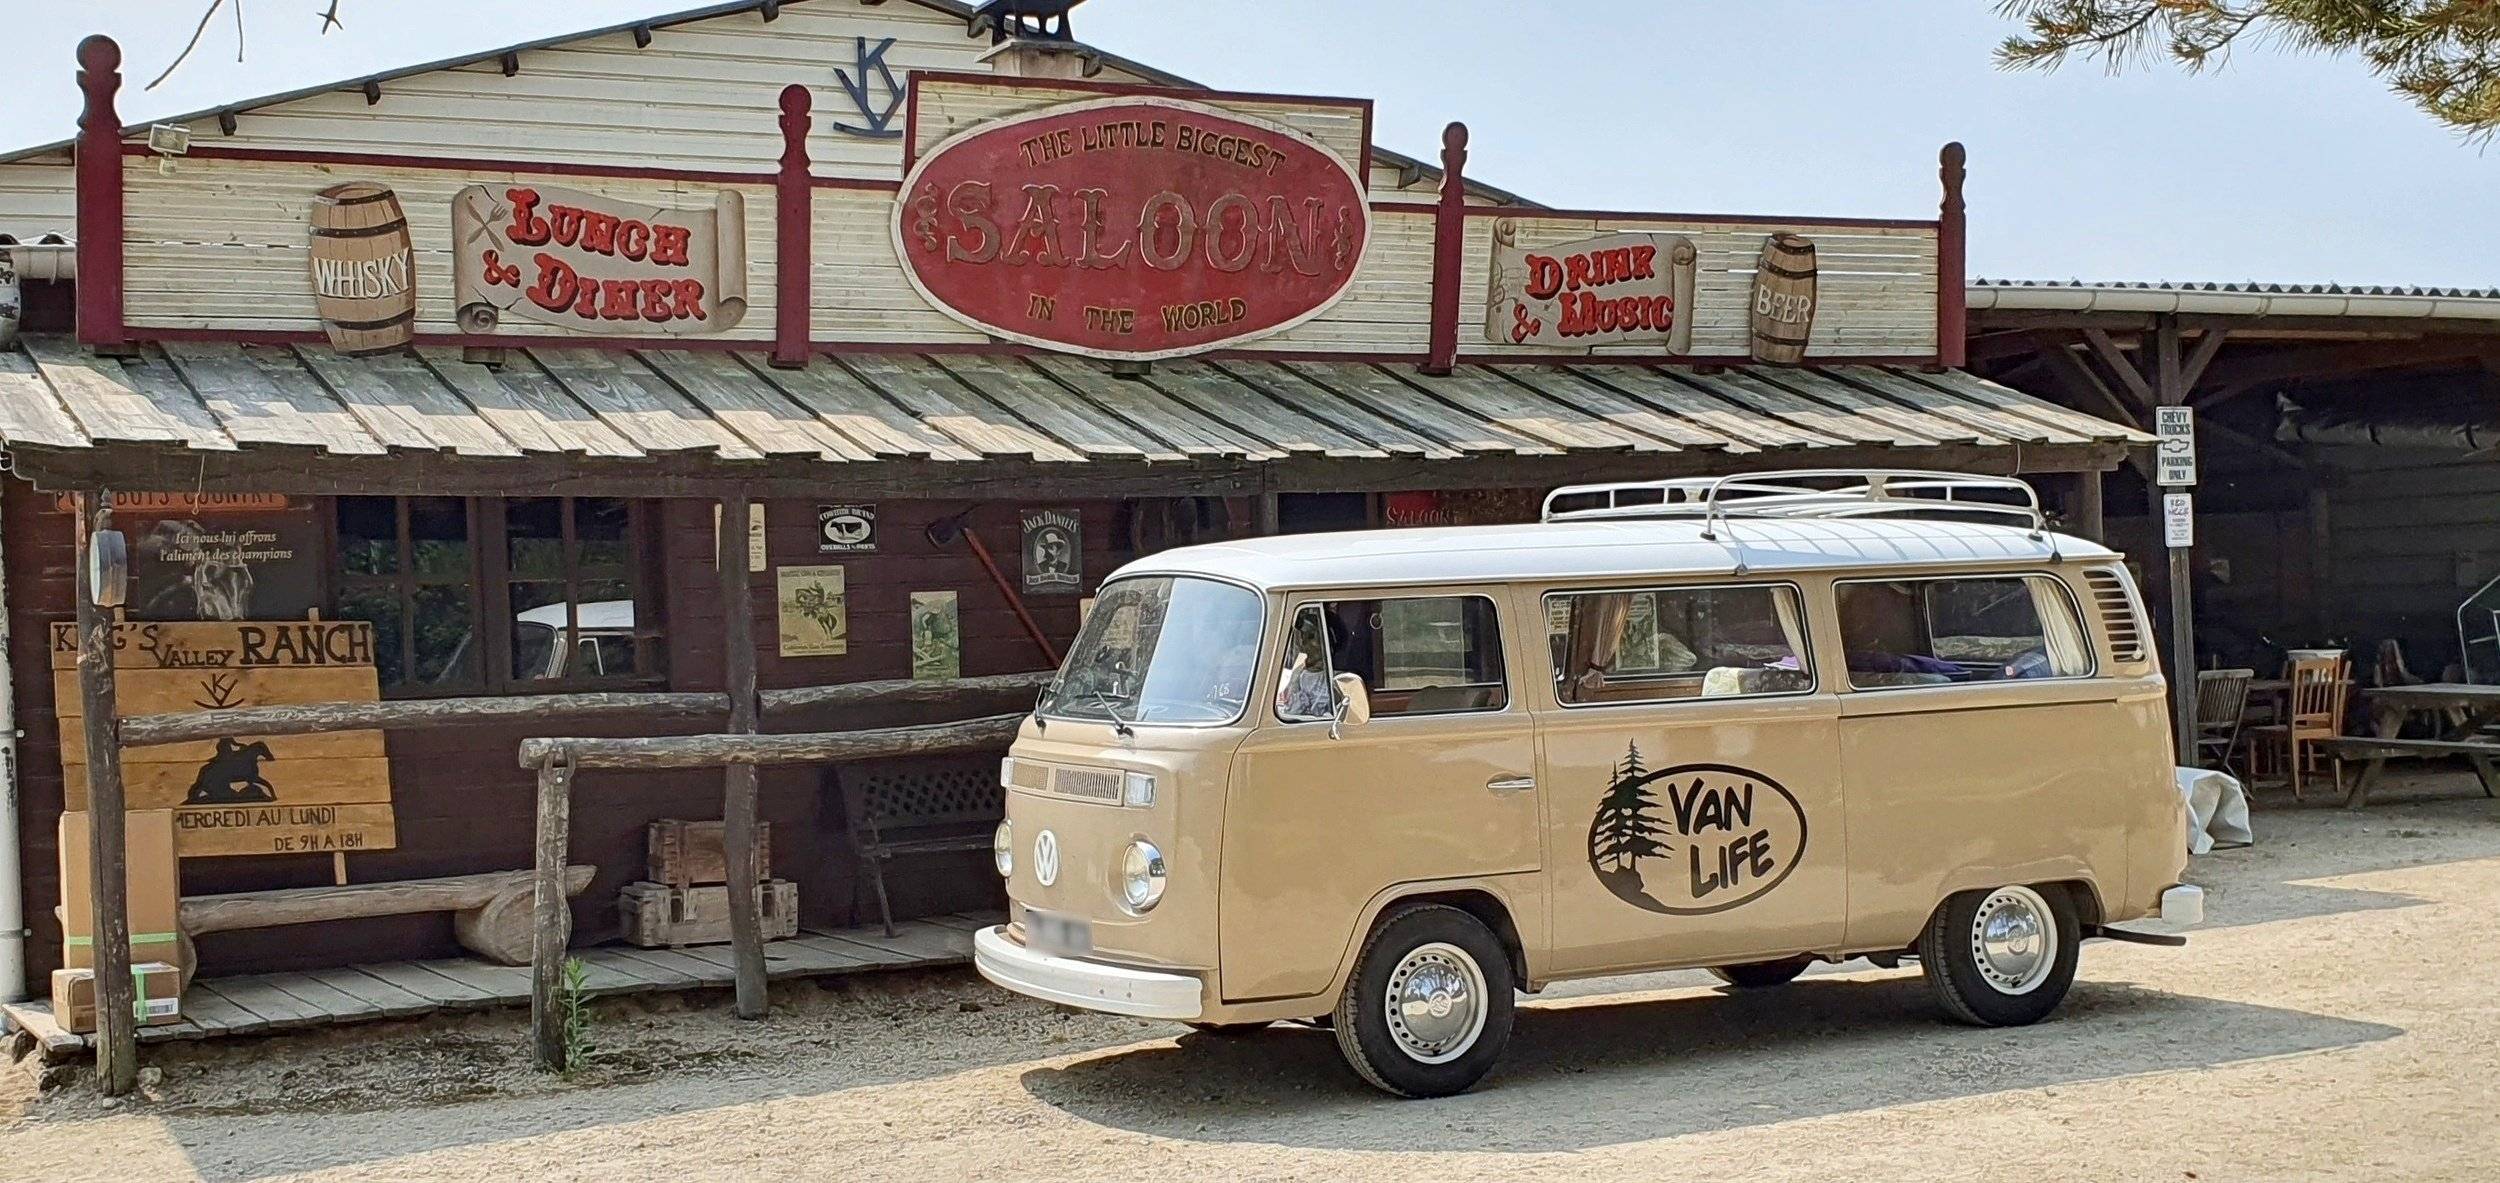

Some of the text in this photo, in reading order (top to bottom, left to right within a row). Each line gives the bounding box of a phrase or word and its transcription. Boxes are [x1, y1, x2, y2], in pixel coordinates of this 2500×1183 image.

[1018, 121, 1287, 177] THE LITTLE BIGGEST
[505, 187, 692, 268] LUNCH
[946, 180, 1326, 277] SALOON
[313, 247, 410, 299] WHISKY
[482, 249, 707, 323] & DINER
[1524, 245, 1657, 300] DRINK
[1027, 293, 1248, 334] IN THE WORLD
[1511, 291, 1674, 344] & MUSIC
[1757, 284, 1811, 323] BEER
[2160, 424, 2190, 435] TRUCKS
[2161, 411, 2188, 424] CHEVY
[2161, 456, 2192, 467] PARKING
[2168, 469, 2187, 480] ONLY
[175, 530, 277, 546] Ici nous lui offrons
[1022, 514, 1045, 533] JACK
[160, 547, 293, 562] l'aliment des champions
[151, 643, 235, 668] VALLEY
[237, 624, 372, 666] RANCH
[256, 809, 282, 826] AU
[290, 807, 336, 825] LUNDI
[1668, 777, 1753, 836] VAN
[274, 832, 363, 851] DE 9H A 18H
[1690, 829, 1775, 898] LIFE
